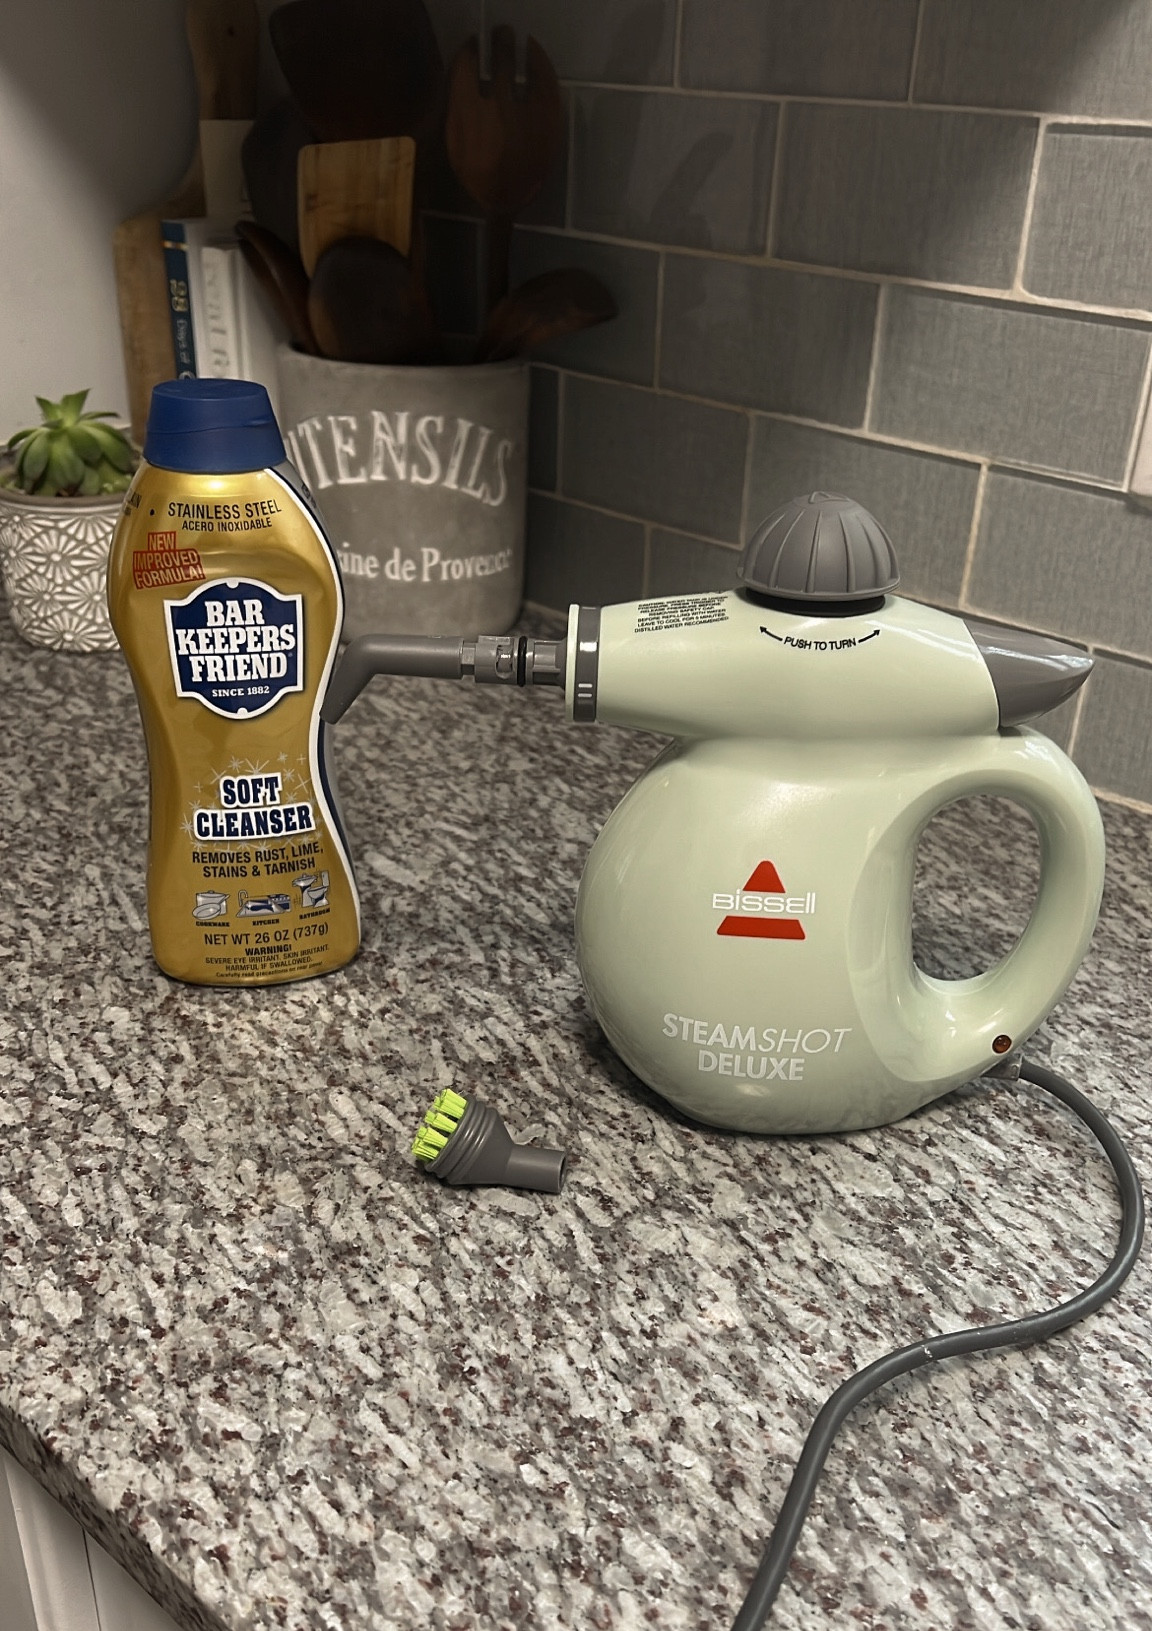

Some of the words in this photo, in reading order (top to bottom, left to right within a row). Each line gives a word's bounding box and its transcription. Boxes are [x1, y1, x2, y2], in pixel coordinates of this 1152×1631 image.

[168, 501, 241, 519] STAINLESS
[245, 499, 282, 518] STEEL
[182, 520, 214, 532] ACERO
[217, 517, 273, 532] INOXIDABLE
[149, 533, 175, 550] NEW
[133, 550, 199, 570] IMPROVED
[385, 546, 417, 582] de
[134, 565, 205, 588] FORMULA!
[204, 599, 265, 627] BAR
[684, 617, 728, 626] RECOMMENDED
[175, 623, 296, 655] KEEPERS
[784, 636, 812, 650] PUSH
[814, 641, 827, 651] TO
[828, 637, 857, 651] TURN
[189, 652, 288, 682] FRIEND
[212, 688, 245, 697] SINCE
[247, 686, 270, 696] 1882
[222, 775, 279, 805] SOFT
[196, 805, 312, 837] CLEANSER
[192, 851, 251, 864] REMOVES
[255, 848, 289, 863] RUST,
[203, 865, 248, 878] STAINS
[252, 866, 261, 876] &
[264, 857, 315, 876] TARNISH
[204, 934, 228, 945] NET
[231, 933, 250, 945] WT
[255, 933, 270, 944] 26
[274, 929, 289, 941] OZ
[293, 922, 329, 940] (737g)
[245, 943, 292, 956] WARNING!
[283, 952, 299, 960] SKIN
[226, 963, 259, 972] HARMFUL
[661, 1012, 853, 1054] STEAMSHOT
[698, 1050, 806, 1081] DELUXE
